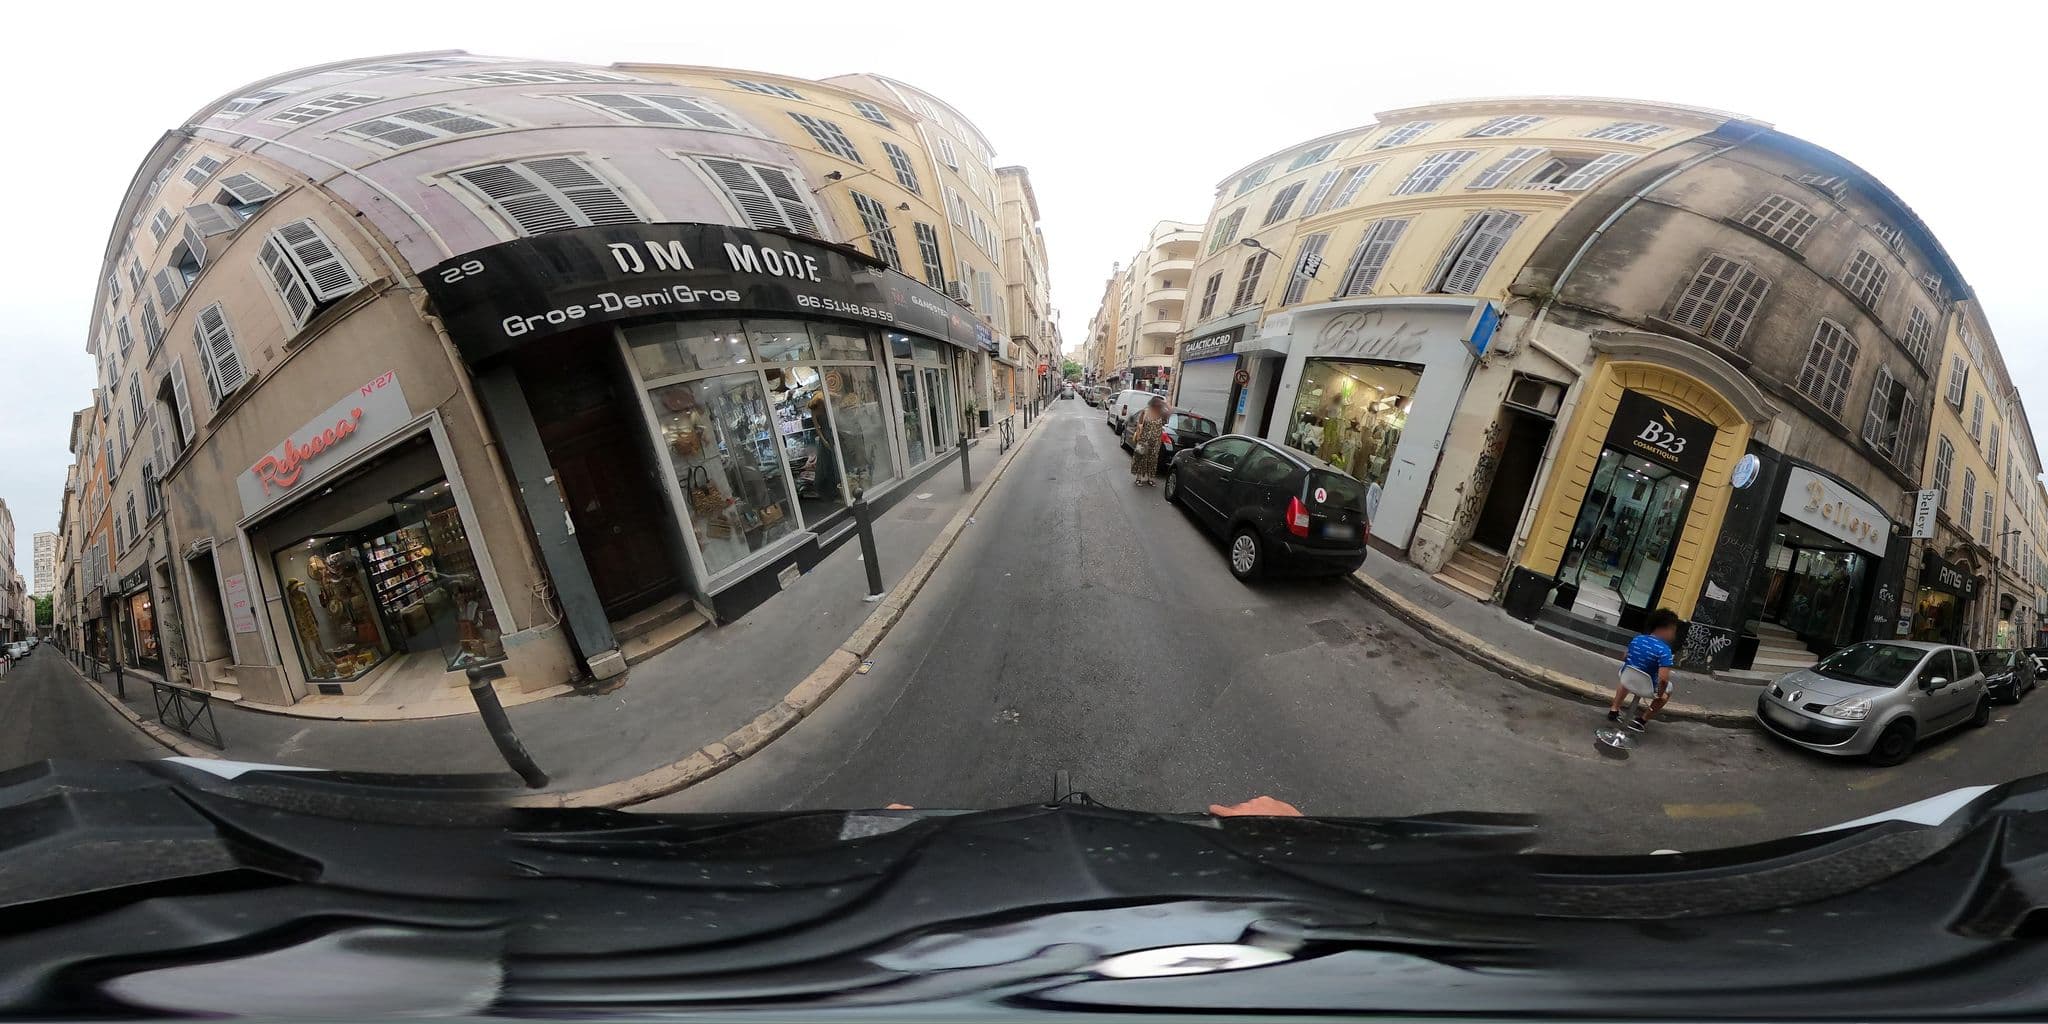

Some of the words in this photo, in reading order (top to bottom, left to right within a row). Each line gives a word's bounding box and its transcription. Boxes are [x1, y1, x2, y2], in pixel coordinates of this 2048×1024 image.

[440, 260, 485, 284] 29
[607, 241, 695, 273] DM
[723, 242, 821, 283] MODE
[797, 294, 894, 322] 06.51.48.83.59
[360, 371, 394, 398] N°27
[1637, 419, 1688, 454] B23
[252, 417, 358, 496] Rebecca
[1633, 440, 1679, 463] COSMETIQUES
[1317, 490, 1324, 500] A
